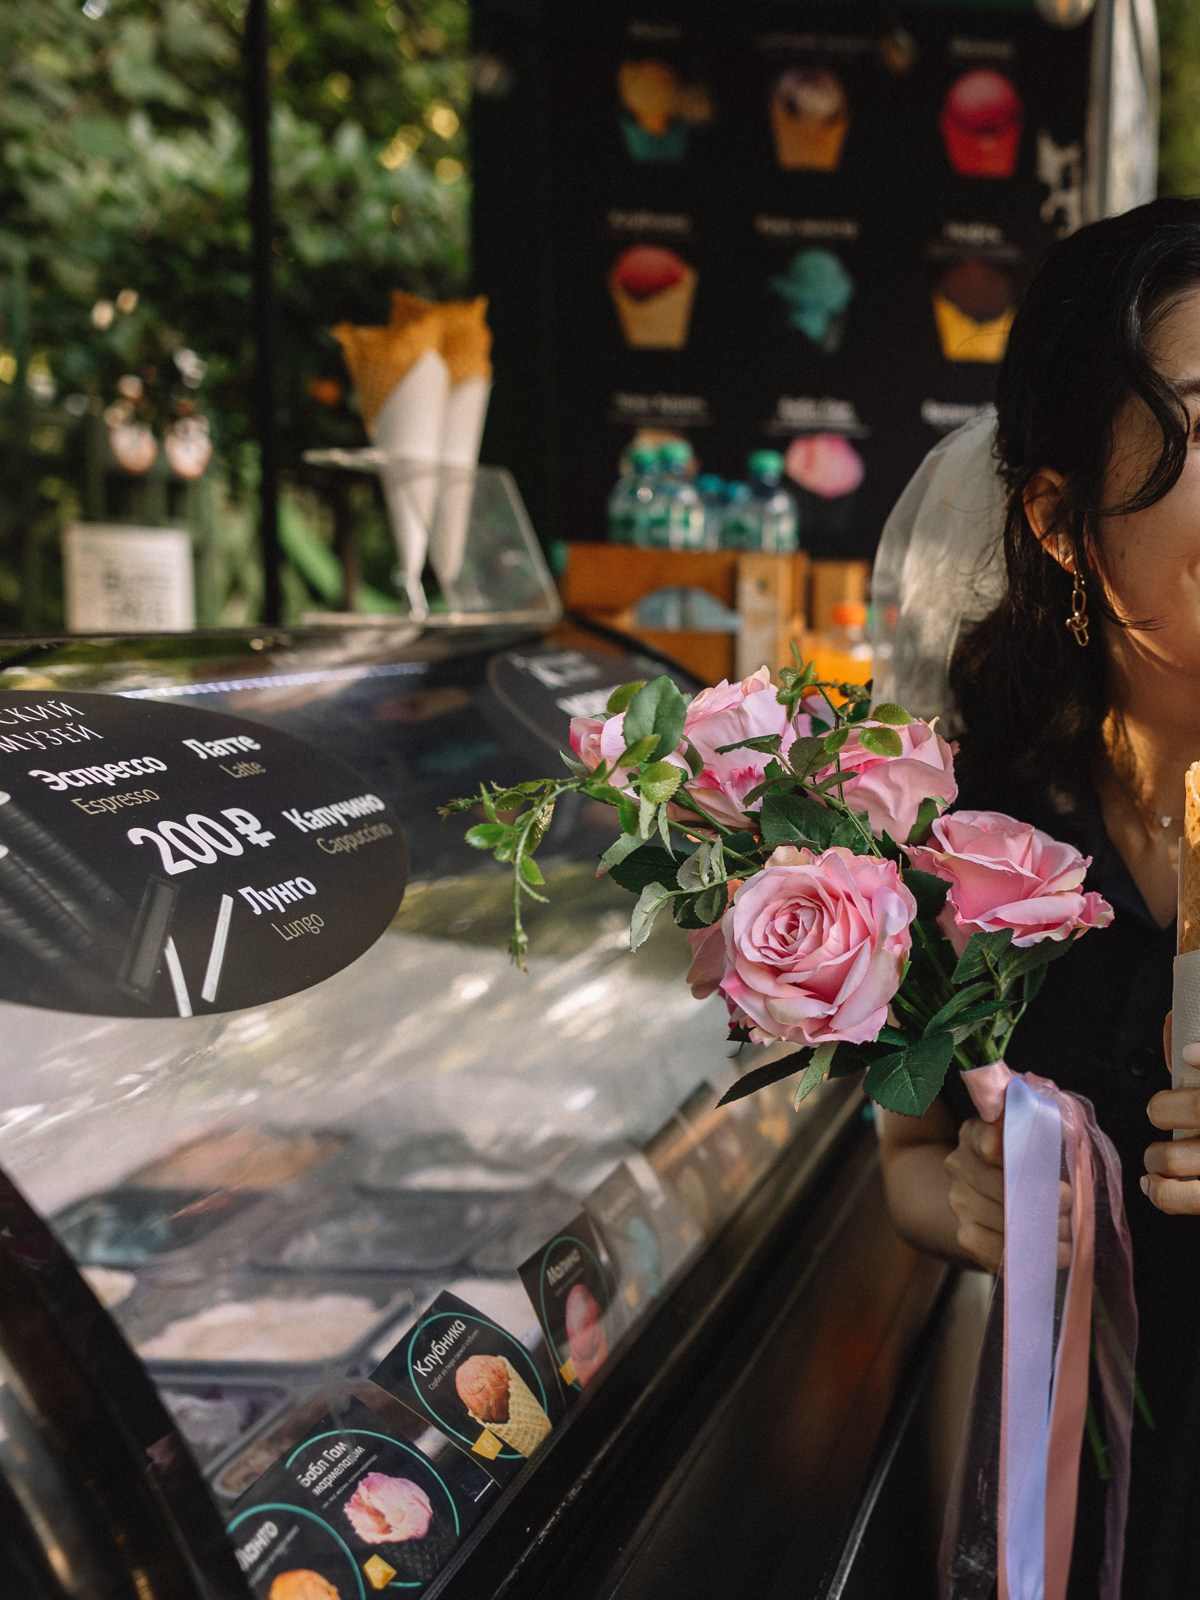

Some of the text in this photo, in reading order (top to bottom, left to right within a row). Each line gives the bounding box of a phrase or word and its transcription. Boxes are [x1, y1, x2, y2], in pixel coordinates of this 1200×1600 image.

[0, 722, 104, 753] МУЗЕЙ
[182, 735, 262, 760] Латте
[28, 755, 168, 791] Эспрессо
[219, 761, 267, 778] Latte
[71, 788, 160, 815] Espresso
[281, 793, 386, 834] Капучино
[237, 876, 317, 915] Лунго
[270, 913, 325, 941] Lungo
[412, 1319, 467, 1377] Клубника
[296, 1459, 330, 1488] Бабл
[322, 1441, 348, 1462] Гам
